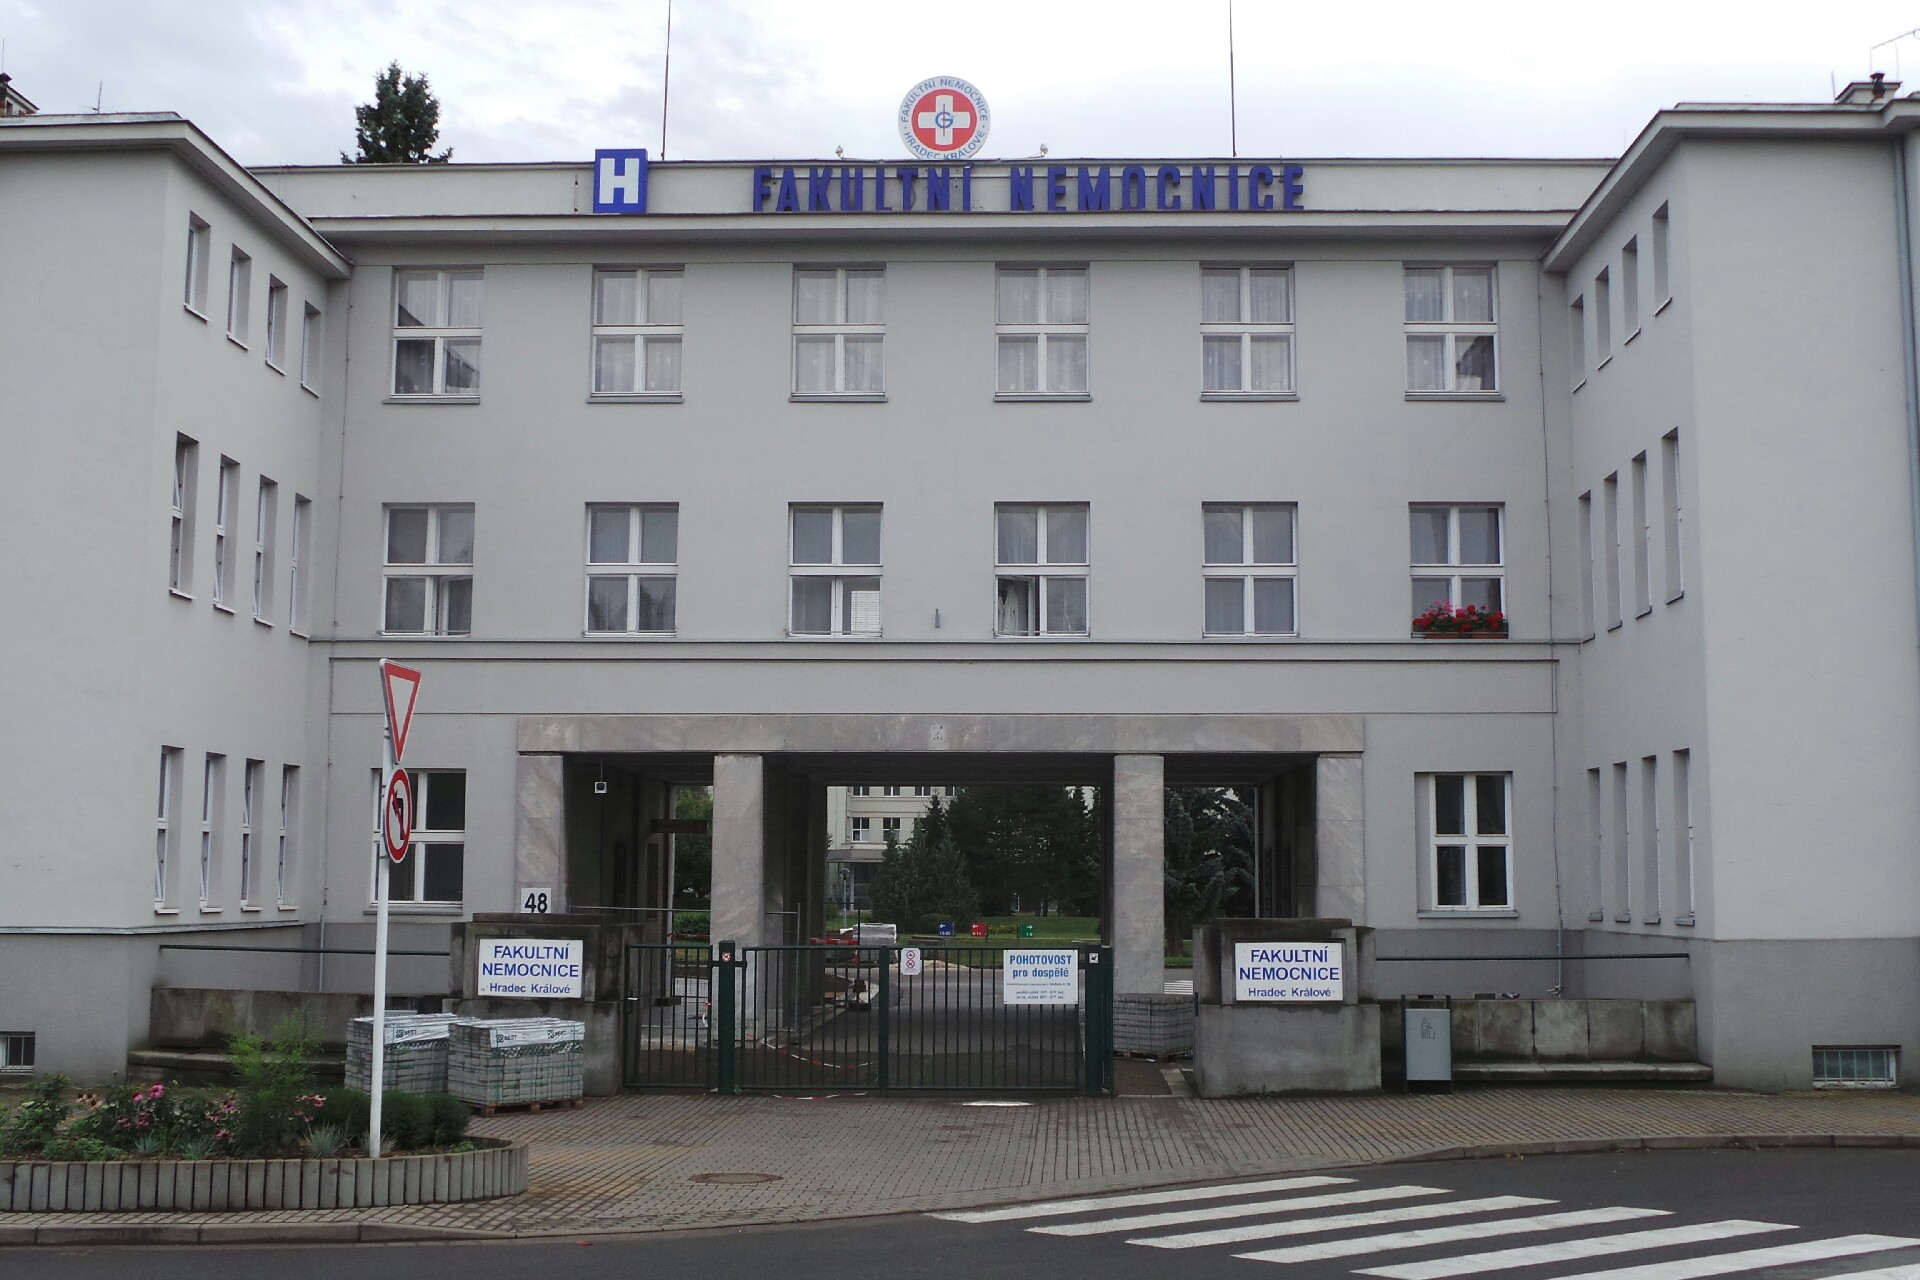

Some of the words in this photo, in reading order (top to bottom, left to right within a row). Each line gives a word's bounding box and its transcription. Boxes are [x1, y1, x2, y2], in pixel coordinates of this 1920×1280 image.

[940, 78, 988, 121] NEMOCNICE
[599, 158, 640, 204] H
[753, 163, 974, 212] FAKULTNÍ
[1010, 165, 1304, 212] NEMOCNICE
[524, 893, 548, 914] 48
[493, 943, 570, 960] FAKULTNÍ
[1250, 946, 1329, 962] FAKULTNÍ
[1009, 954, 1072, 965] POHOTOVOST
[482, 962, 579, 977] NEMOCNICE
[1012, 969, 1028, 979] pro
[1032, 967, 1069, 979] dospělé
[1240, 967, 1339, 980] NEMOCNICE
[489, 982, 526, 994] Hradec
[531, 983, 571, 994] Králové
[1248, 987, 1287, 997] Hradec
[1291, 987, 1332, 997] Králové
